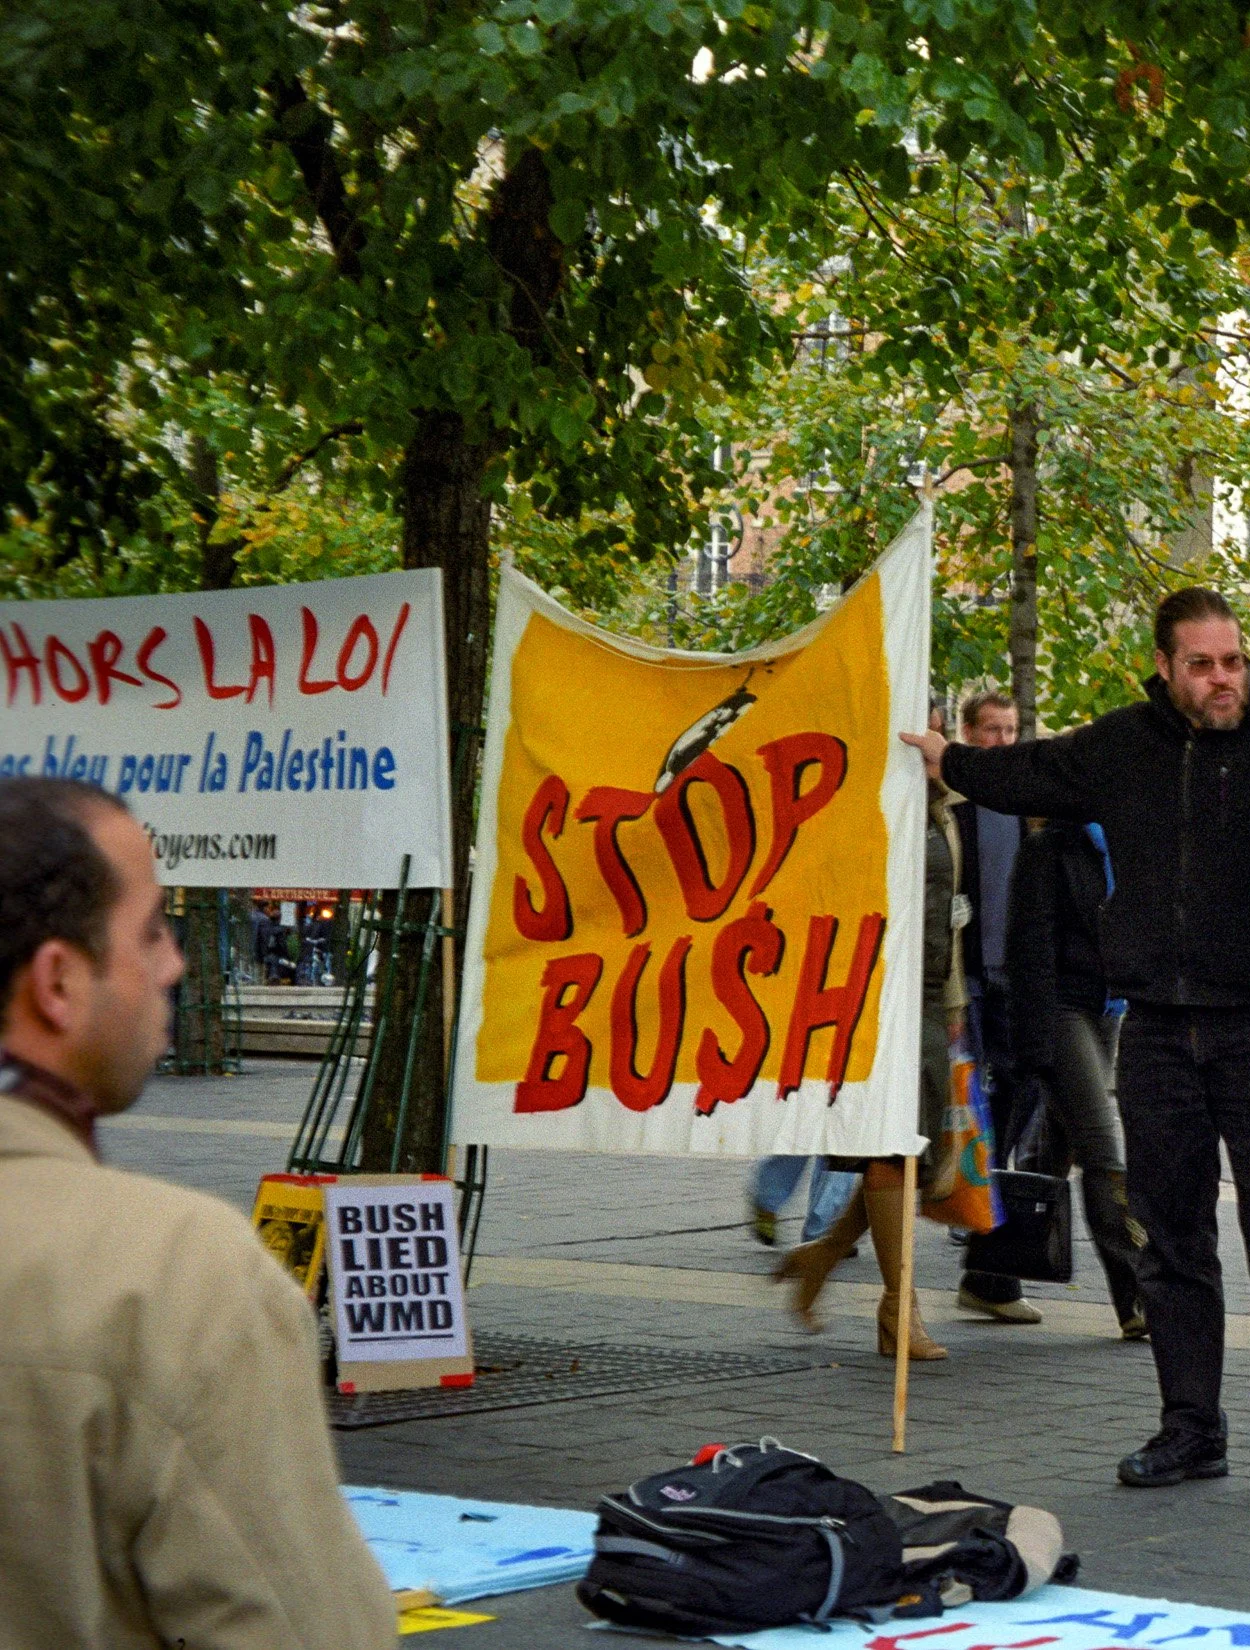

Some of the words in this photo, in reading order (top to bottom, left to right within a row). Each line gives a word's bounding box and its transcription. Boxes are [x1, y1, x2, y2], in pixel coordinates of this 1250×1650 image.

[0, 621, 182, 710] HORS
[193, 613, 276, 712] LA
[43, 735, 108, 787] bleu
[117, 753, 192, 797] pour
[199, 731, 228, 793] la
[238, 728, 397, 793] Palestine
[144, 821, 278, 871] toyens.com
[512, 731, 848, 942] STOP
[337, 1202, 445, 1234] BUSH
[340, 1235, 449, 1271] LIED
[345, 1272, 450, 1299] ABOUT
[344, 1299, 454, 1334] WMD
